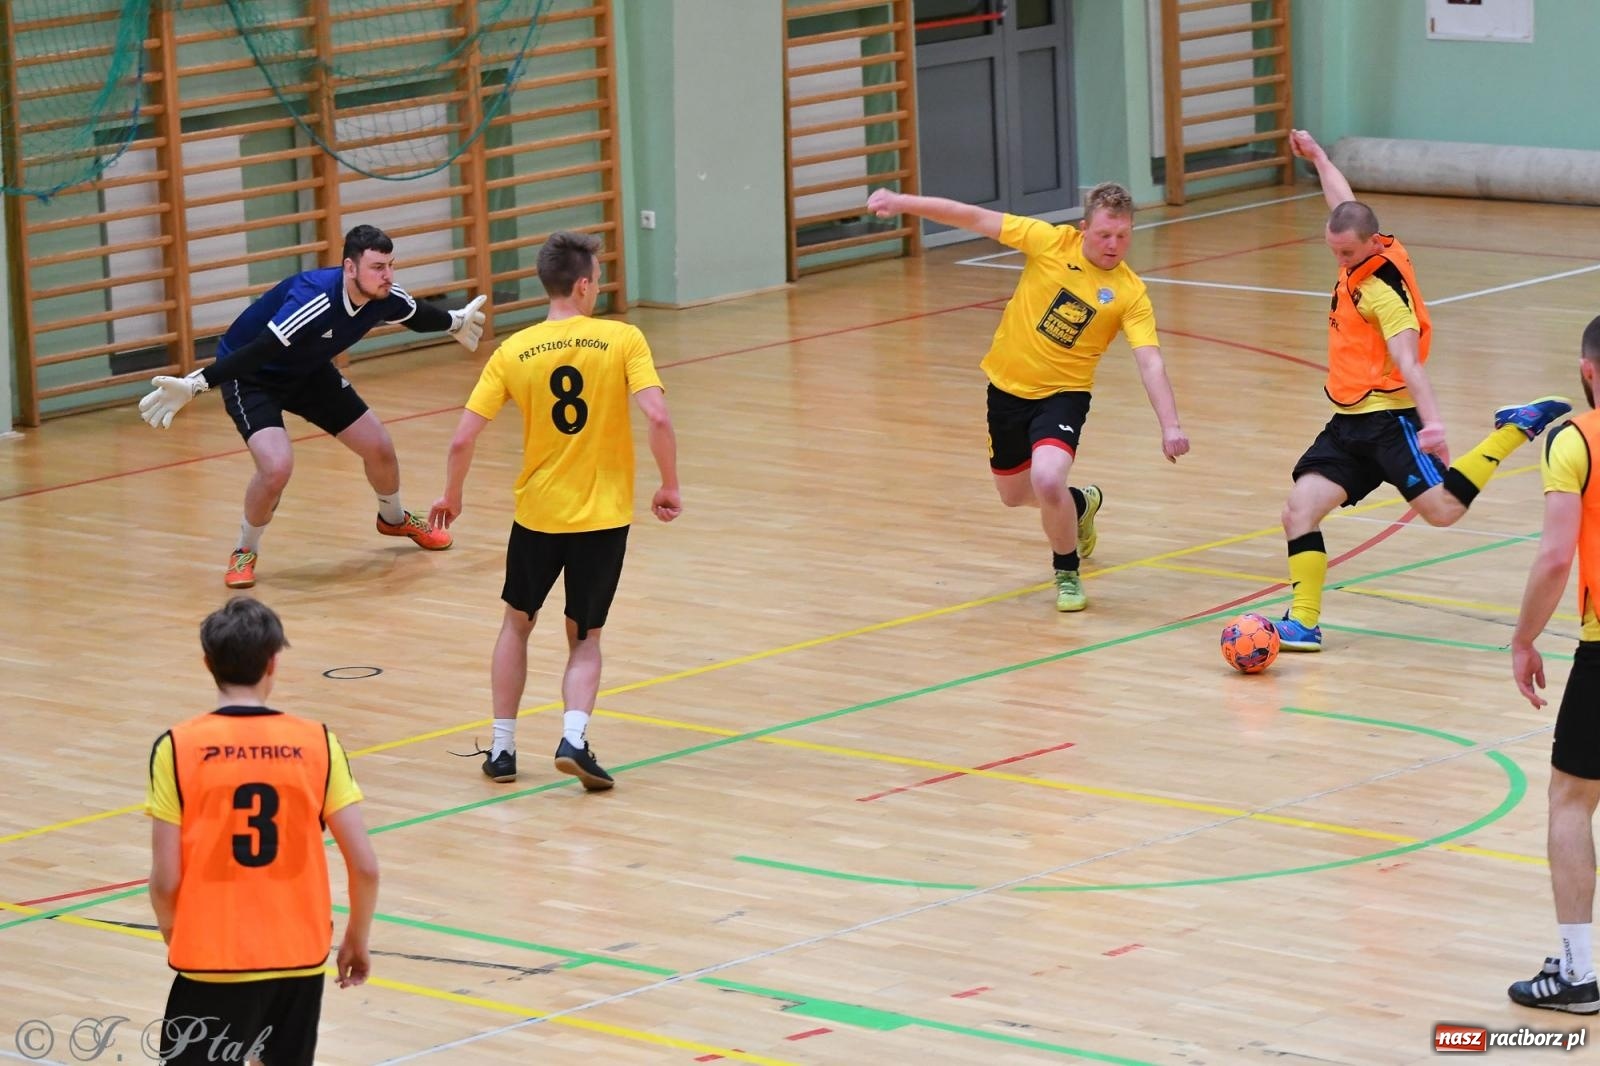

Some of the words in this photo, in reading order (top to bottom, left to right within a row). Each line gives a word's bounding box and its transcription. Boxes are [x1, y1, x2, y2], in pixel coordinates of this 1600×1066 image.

[518, 338, 572, 362] PRZYSZŁOŚĆ
[575, 338, 609, 351] ROGÓW
[549, 365, 588, 435] 8
[224, 745, 303, 760] PATRICK
[232, 782, 279, 868] 3
